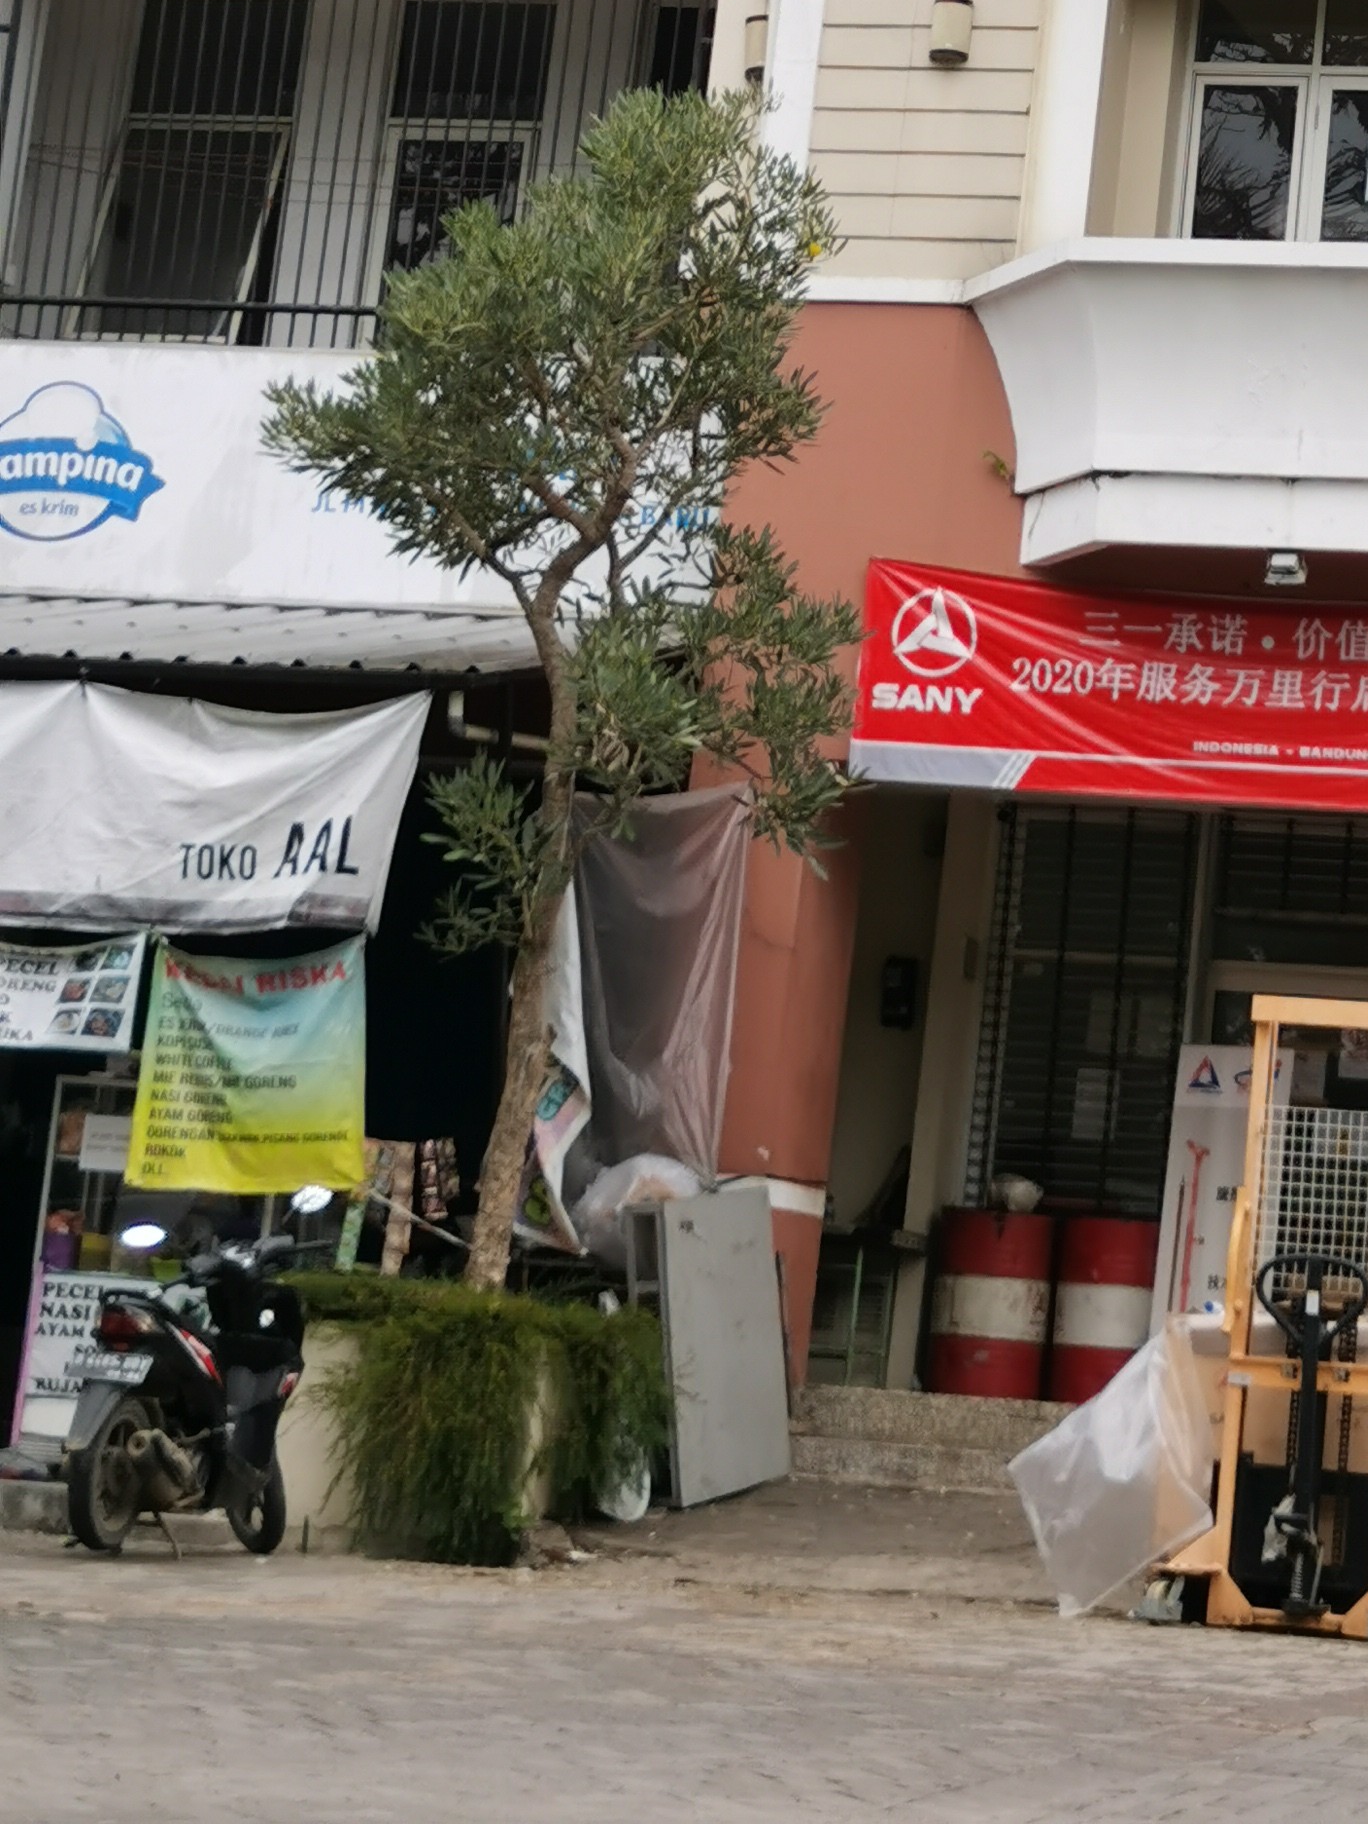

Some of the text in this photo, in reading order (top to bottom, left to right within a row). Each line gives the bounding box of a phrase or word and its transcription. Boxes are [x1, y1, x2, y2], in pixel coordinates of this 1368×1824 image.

[18, 497, 80, 517] es krim
[871, 682, 984, 715] SANY
[1193, 741, 1279, 756] INDONESIA
[180, 814, 360, 880] TOKO AAL
[150, 1089, 180, 1102] NASI
[148, 1107, 183, 1121] AYAM
[39, 1301, 92, 1321] NASI
[35, 1322, 85, 1338] AYAM
